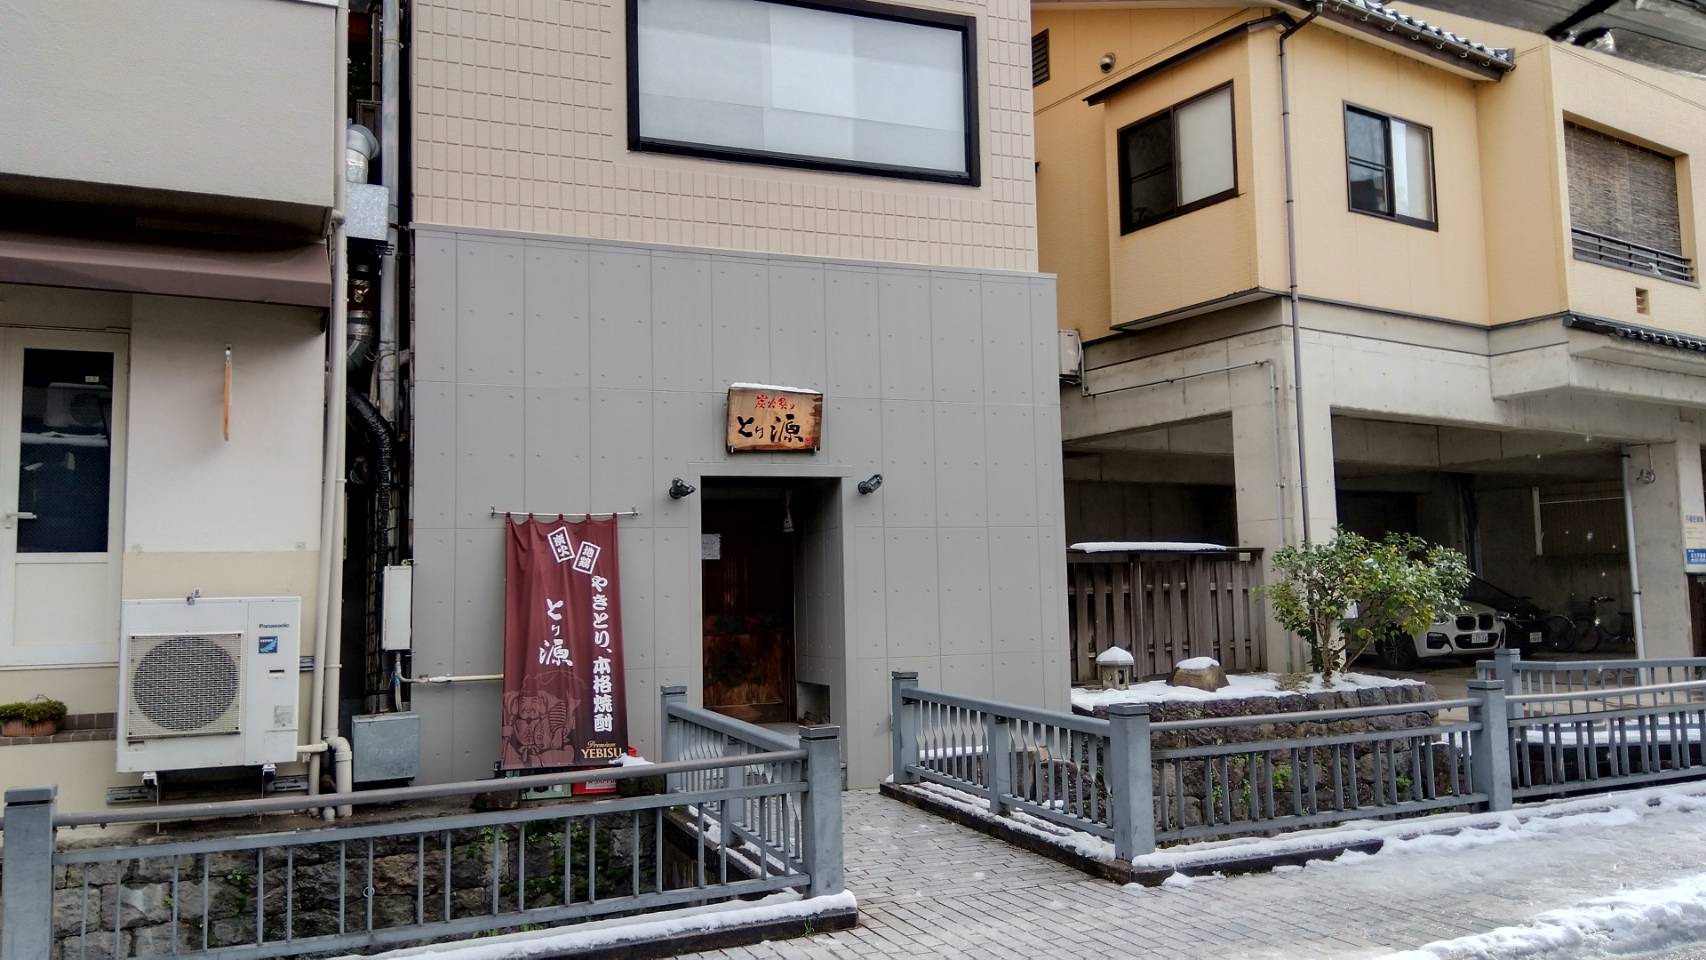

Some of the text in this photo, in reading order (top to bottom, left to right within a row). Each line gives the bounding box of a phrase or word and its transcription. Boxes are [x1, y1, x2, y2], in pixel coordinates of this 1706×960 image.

[736, 413, 804, 443] とり源
[539, 598, 573, 667] とり源
[591, 575, 613, 733] やきとり、本格焼酎
[580, 747, 622, 759] YEBISU
